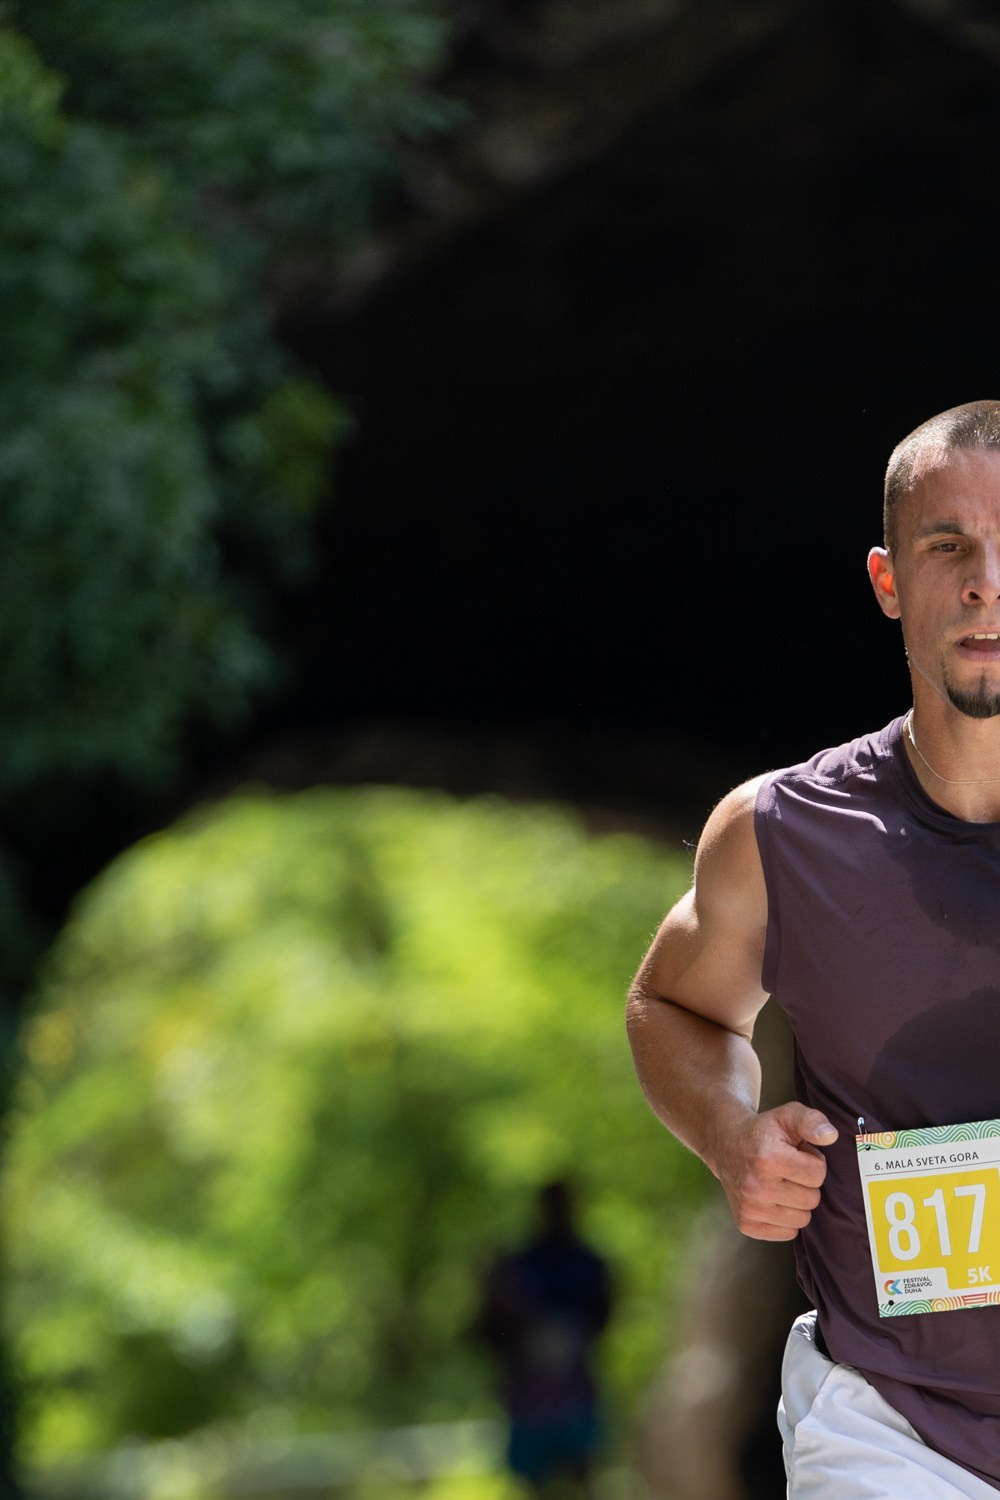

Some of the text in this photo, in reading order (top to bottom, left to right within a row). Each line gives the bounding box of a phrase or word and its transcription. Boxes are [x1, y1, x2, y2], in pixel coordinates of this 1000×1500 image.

[874, 1151, 979, 1171] 6. MALA SVETA GORA
[884, 1183, 987, 1261] 817
[903, 1276, 930, 1284] FESTIVAL
[967, 1266, 993, 1284] 5K
[904, 1281, 933, 1289] ZDRAVOG
